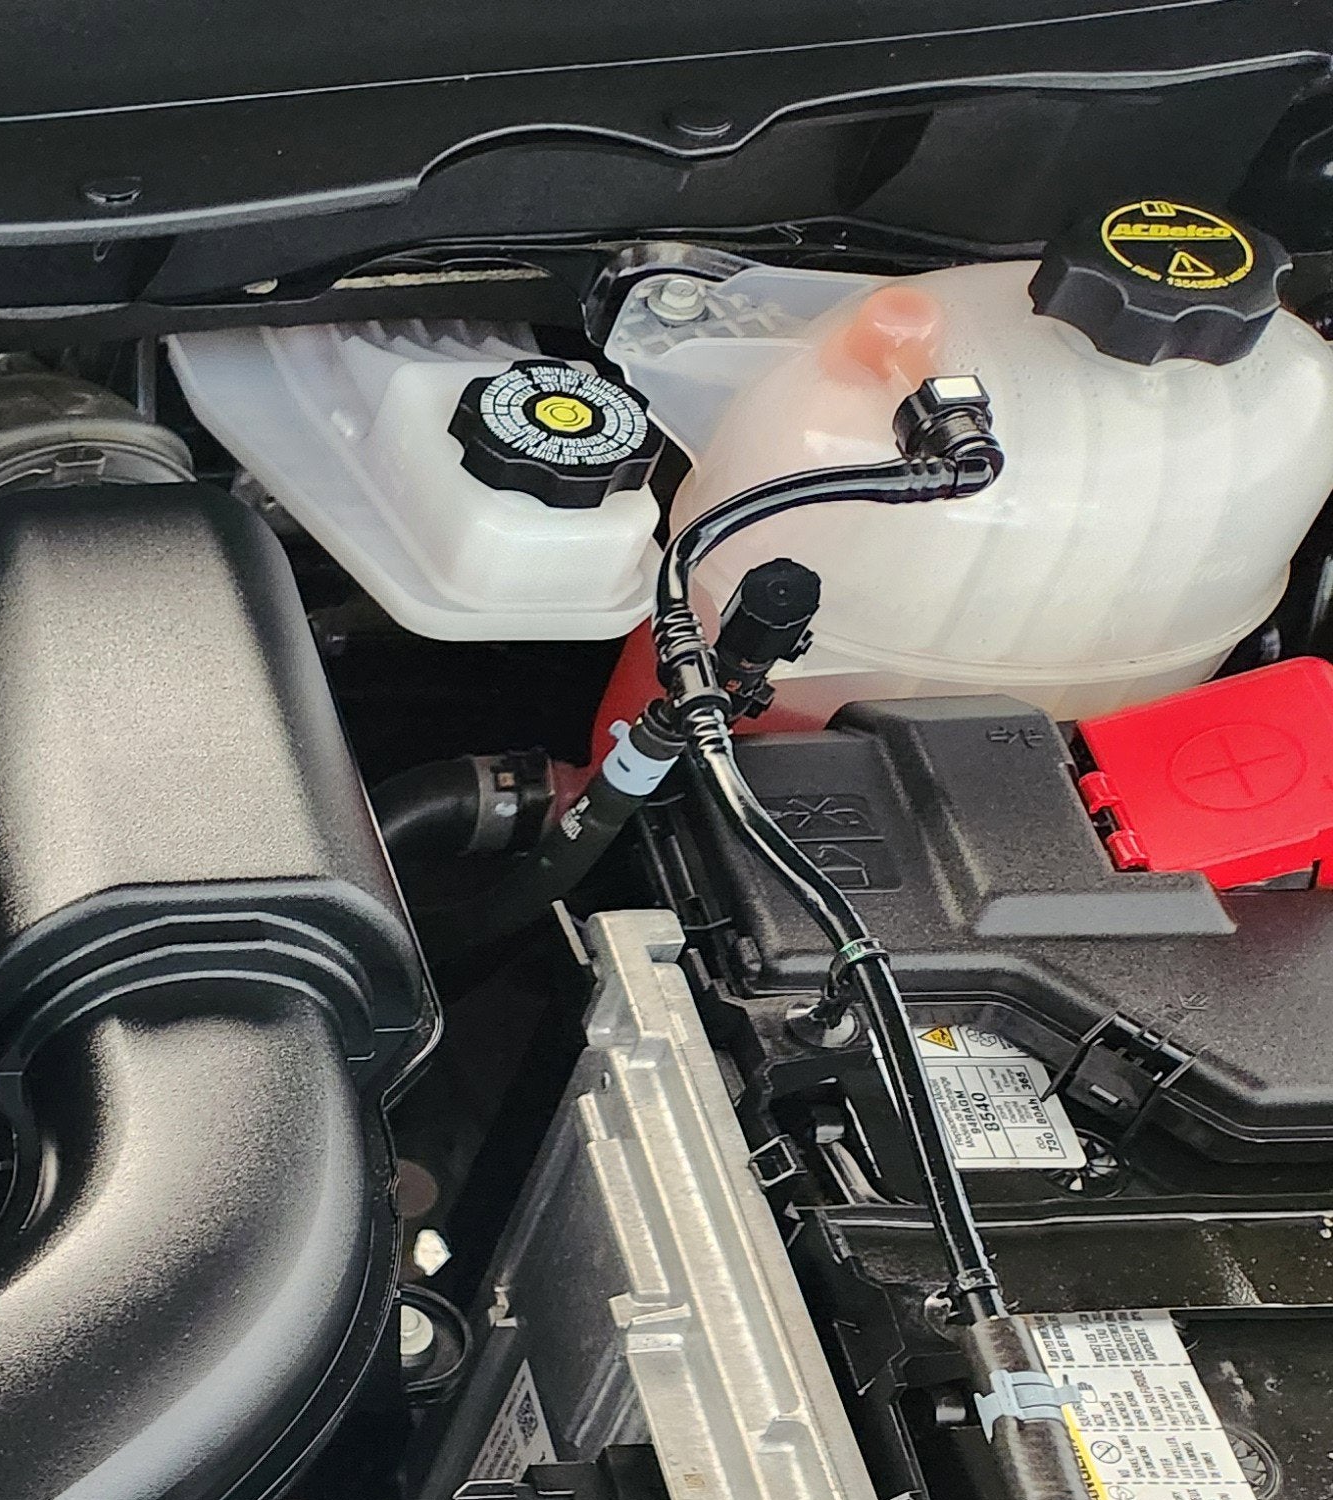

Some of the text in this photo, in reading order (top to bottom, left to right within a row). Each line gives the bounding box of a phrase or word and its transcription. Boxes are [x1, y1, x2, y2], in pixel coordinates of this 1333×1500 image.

[1112, 223, 1233, 238] ACDelco
[1015, 1071, 1031, 1089] 365
[953, 1090, 981, 1133] 94RAGM
[970, 1092, 1000, 1130] 8540
[1026, 1098, 1047, 1123] 80Ah
[1042, 1132, 1060, 1151] 730
